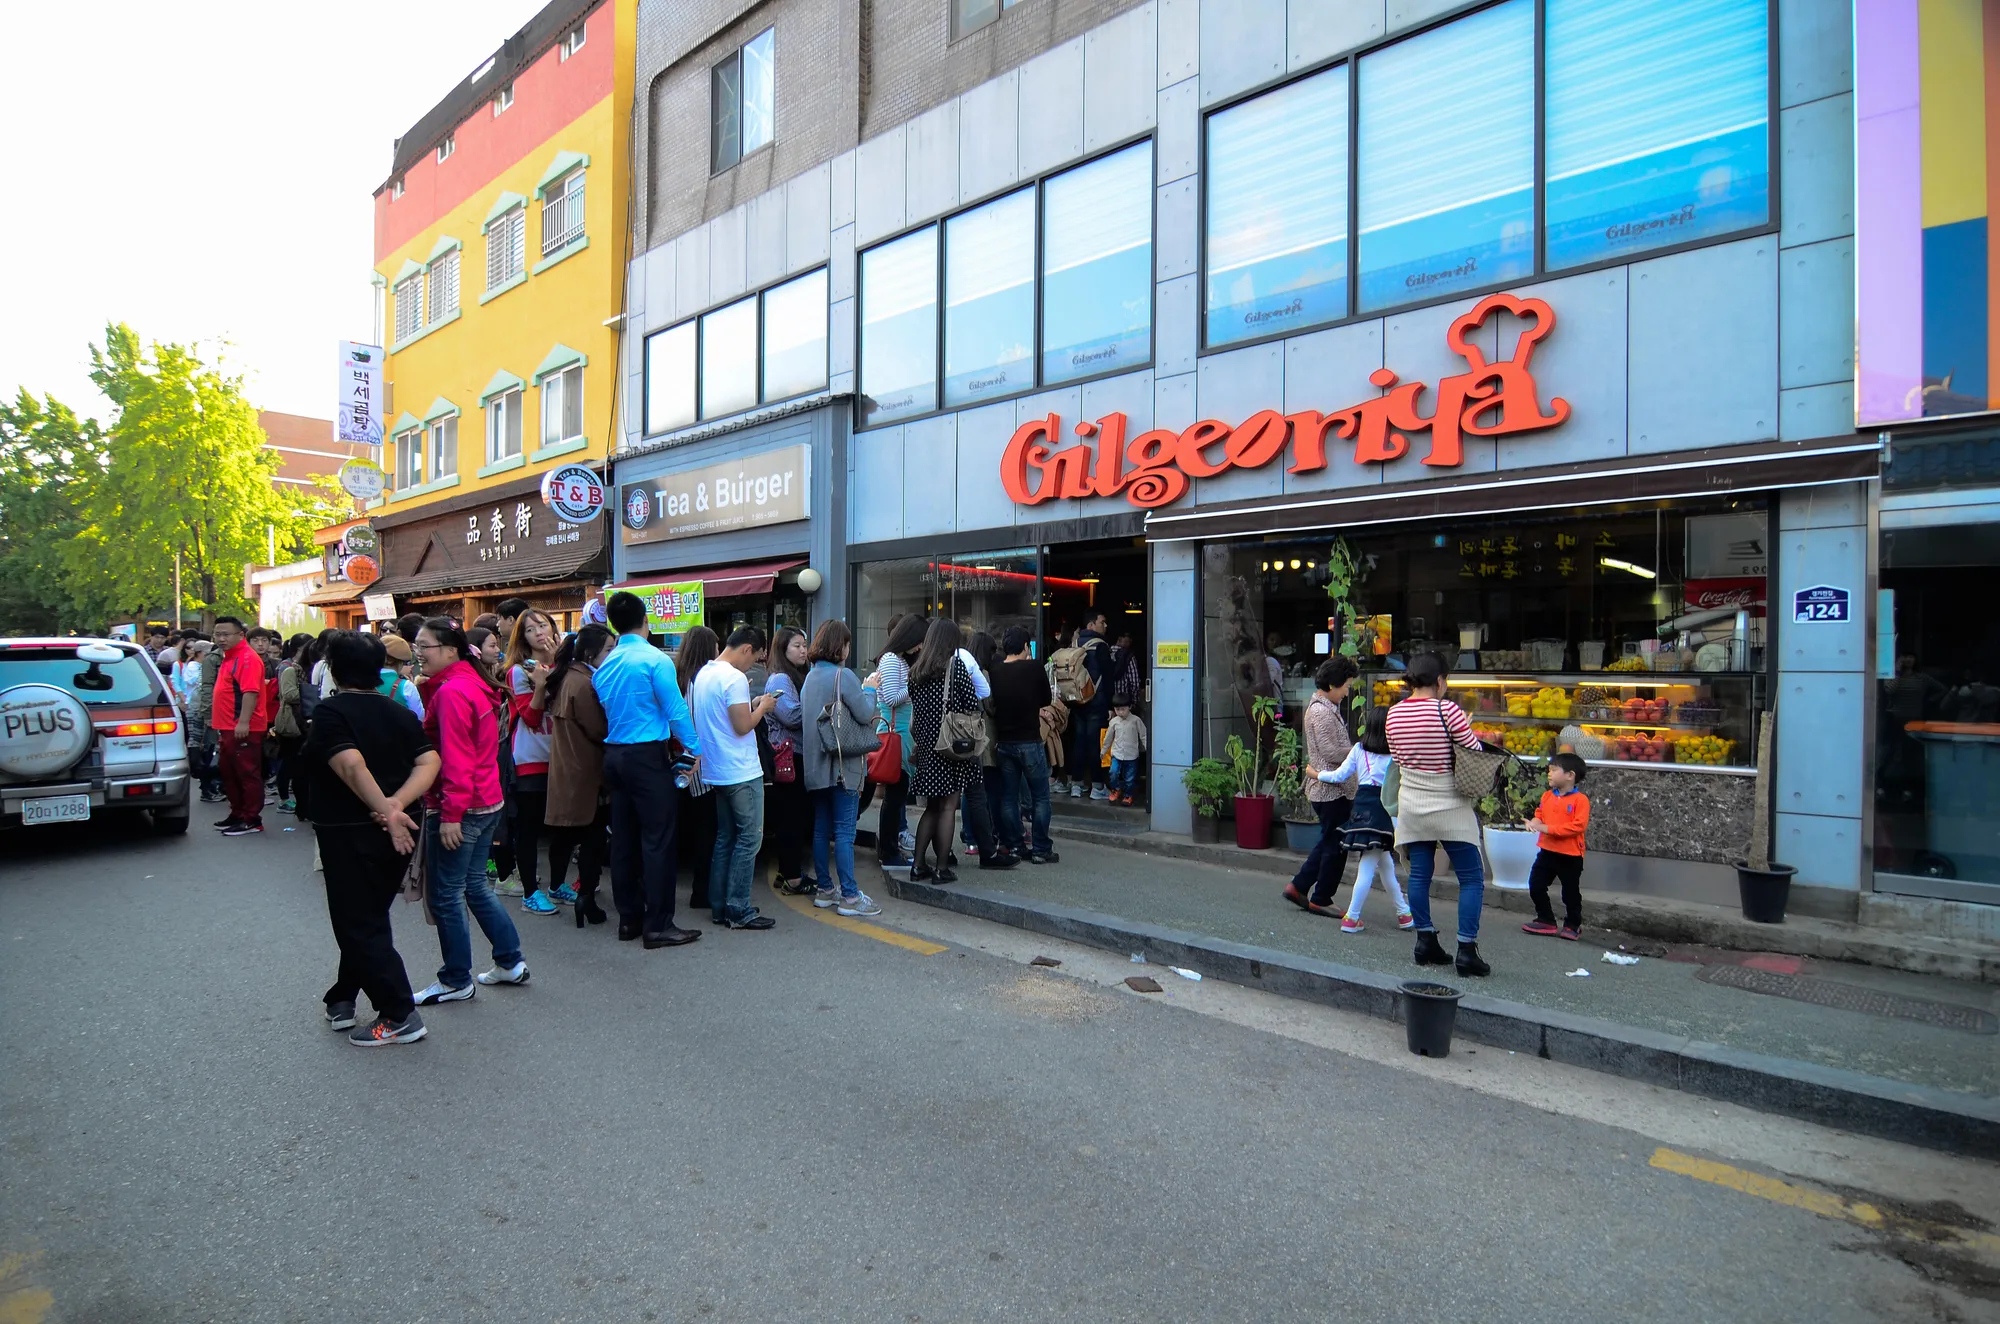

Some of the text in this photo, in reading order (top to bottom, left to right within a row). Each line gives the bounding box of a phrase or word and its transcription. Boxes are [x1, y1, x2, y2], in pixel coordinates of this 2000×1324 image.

[1000, 294, 1572, 508] Gilgeoriya
[654, 489, 690, 519] Tea
[695, 482, 710, 512] &
[467, 502, 533, 545] 品香街
[679, 522, 699, 533] ESPRESSO
[700, 520, 715, 530] COFFEE
[653, 592, 682, 617] 점보롤
[682, 591, 701, 614] 입점
[1805, 603, 1841, 619] 124
[5, 708, 75, 739] PLUS
